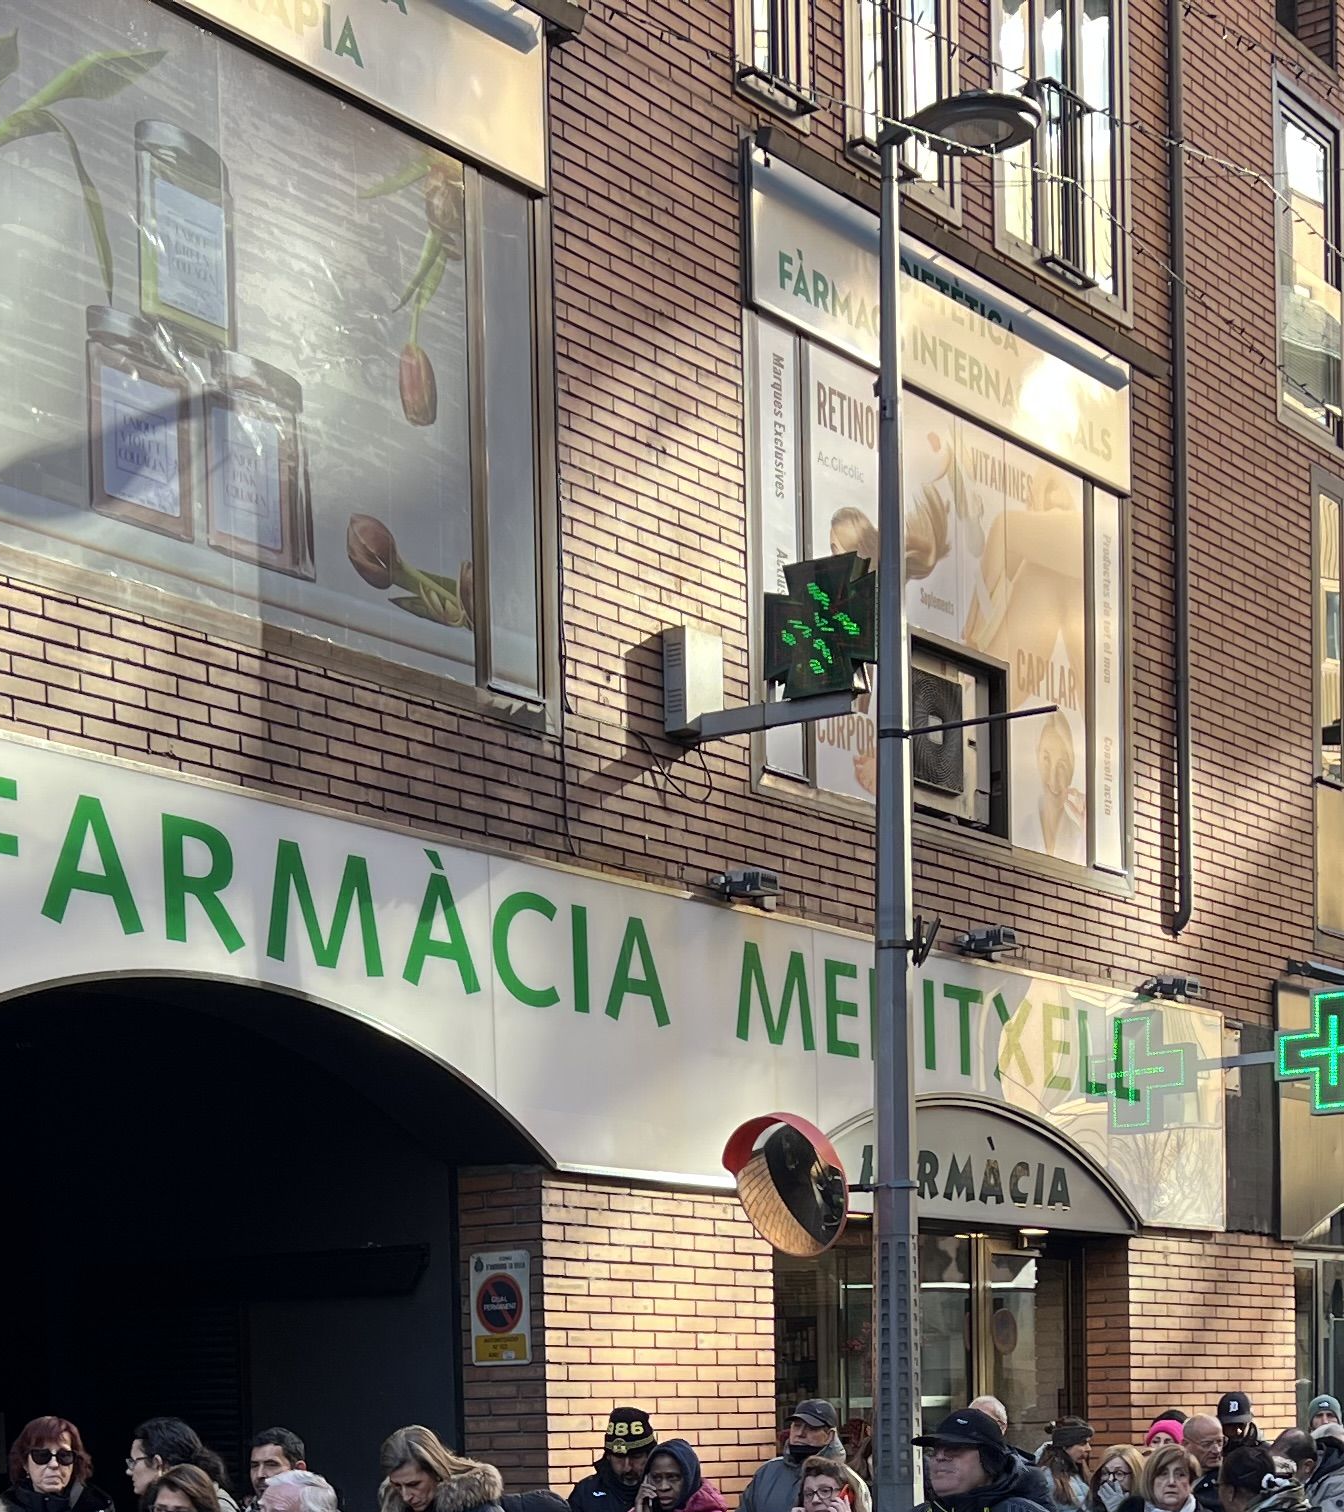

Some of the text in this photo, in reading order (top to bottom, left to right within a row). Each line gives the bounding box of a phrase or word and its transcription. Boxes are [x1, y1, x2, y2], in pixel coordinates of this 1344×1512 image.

[771, 352, 785, 499] Marques Exclusives
[817, 380, 880, 450] RETINO
[971, 447, 1034, 506] VITAMINES
[1016, 648, 1077, 711] CAPILAR
[736, 941, 1140, 1102] MEITXELL
